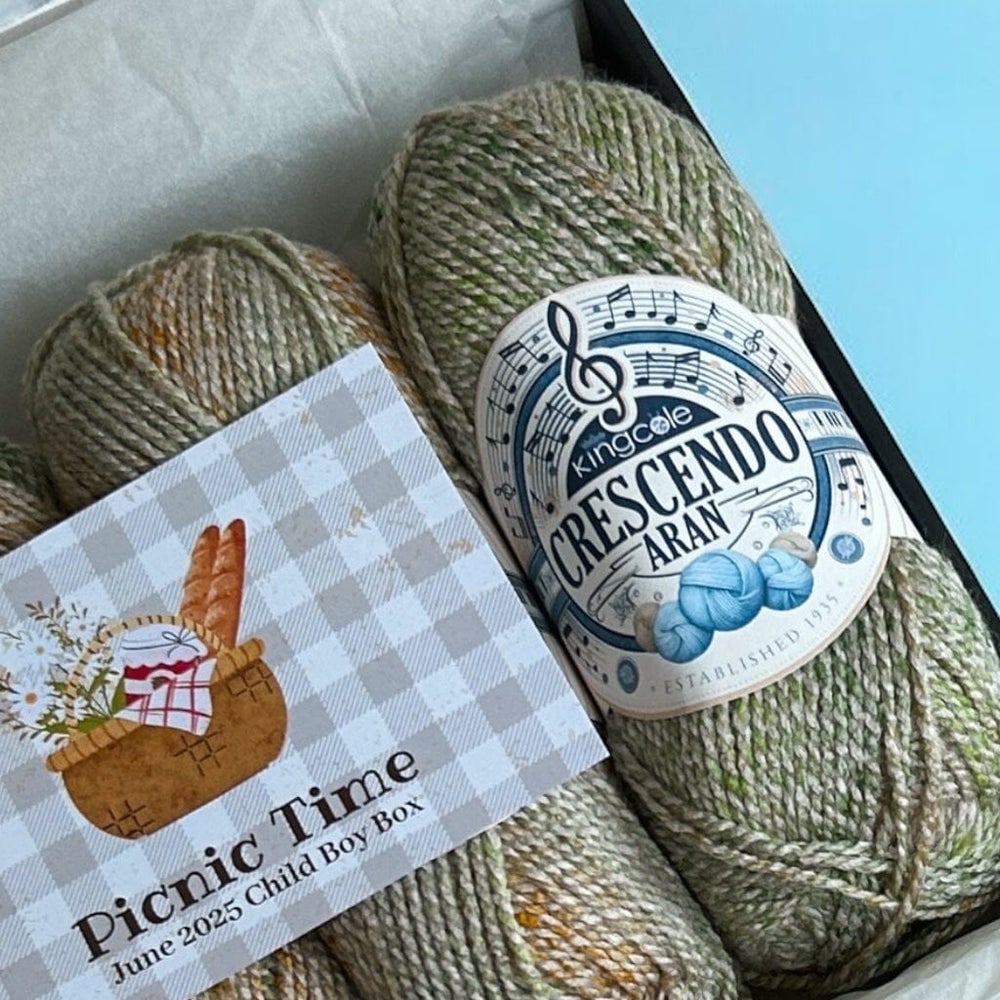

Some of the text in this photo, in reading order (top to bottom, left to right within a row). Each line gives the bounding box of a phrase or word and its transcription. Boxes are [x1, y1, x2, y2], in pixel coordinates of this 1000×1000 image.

[549, 409, 801, 589] CRESCENDO
[641, 498, 732, 572] ARAN
[664, 593, 839, 694] ESTABLISHED 1935
[71, 749, 420, 963] Picnic Time
[111, 796, 425, 985] June 2025 Child Boy Box
